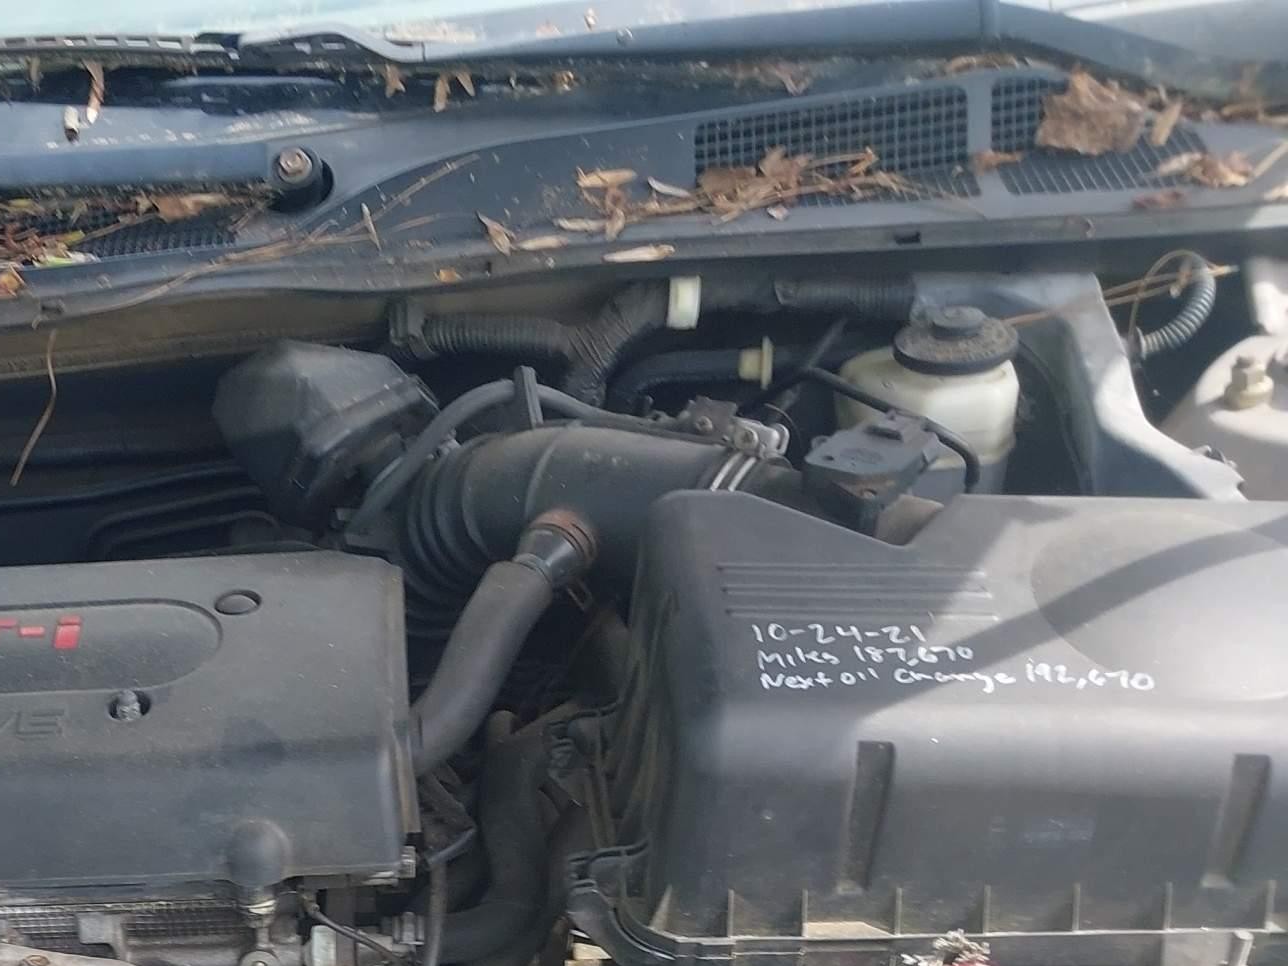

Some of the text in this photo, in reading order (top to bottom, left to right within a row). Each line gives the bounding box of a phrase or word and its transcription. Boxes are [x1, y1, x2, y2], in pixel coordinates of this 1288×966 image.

[752, 623, 926, 644] 10-24-21
[757, 645, 974, 671] Miles 187,670
[760, 672, 833, 690] Next
[1026, 657, 1155, 690] 192,670
